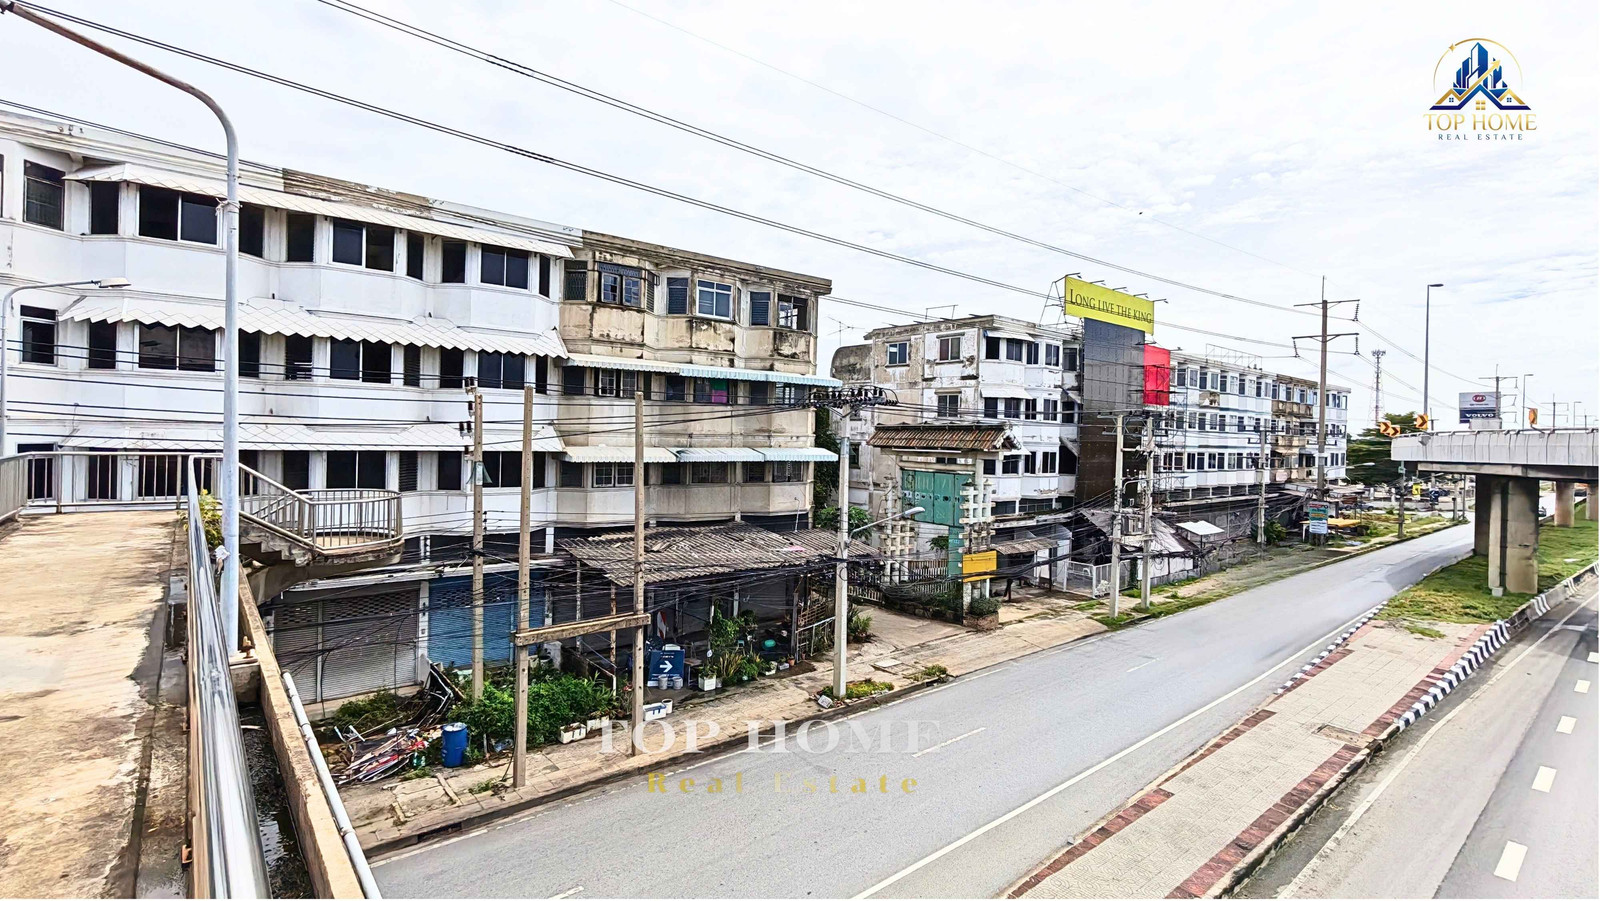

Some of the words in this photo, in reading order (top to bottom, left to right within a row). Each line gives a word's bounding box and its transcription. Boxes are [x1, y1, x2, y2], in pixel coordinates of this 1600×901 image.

[1098, 299, 1115, 314] LIVE
[1116, 304, 1132, 319] THE
[1133, 309, 1152, 323] KING
